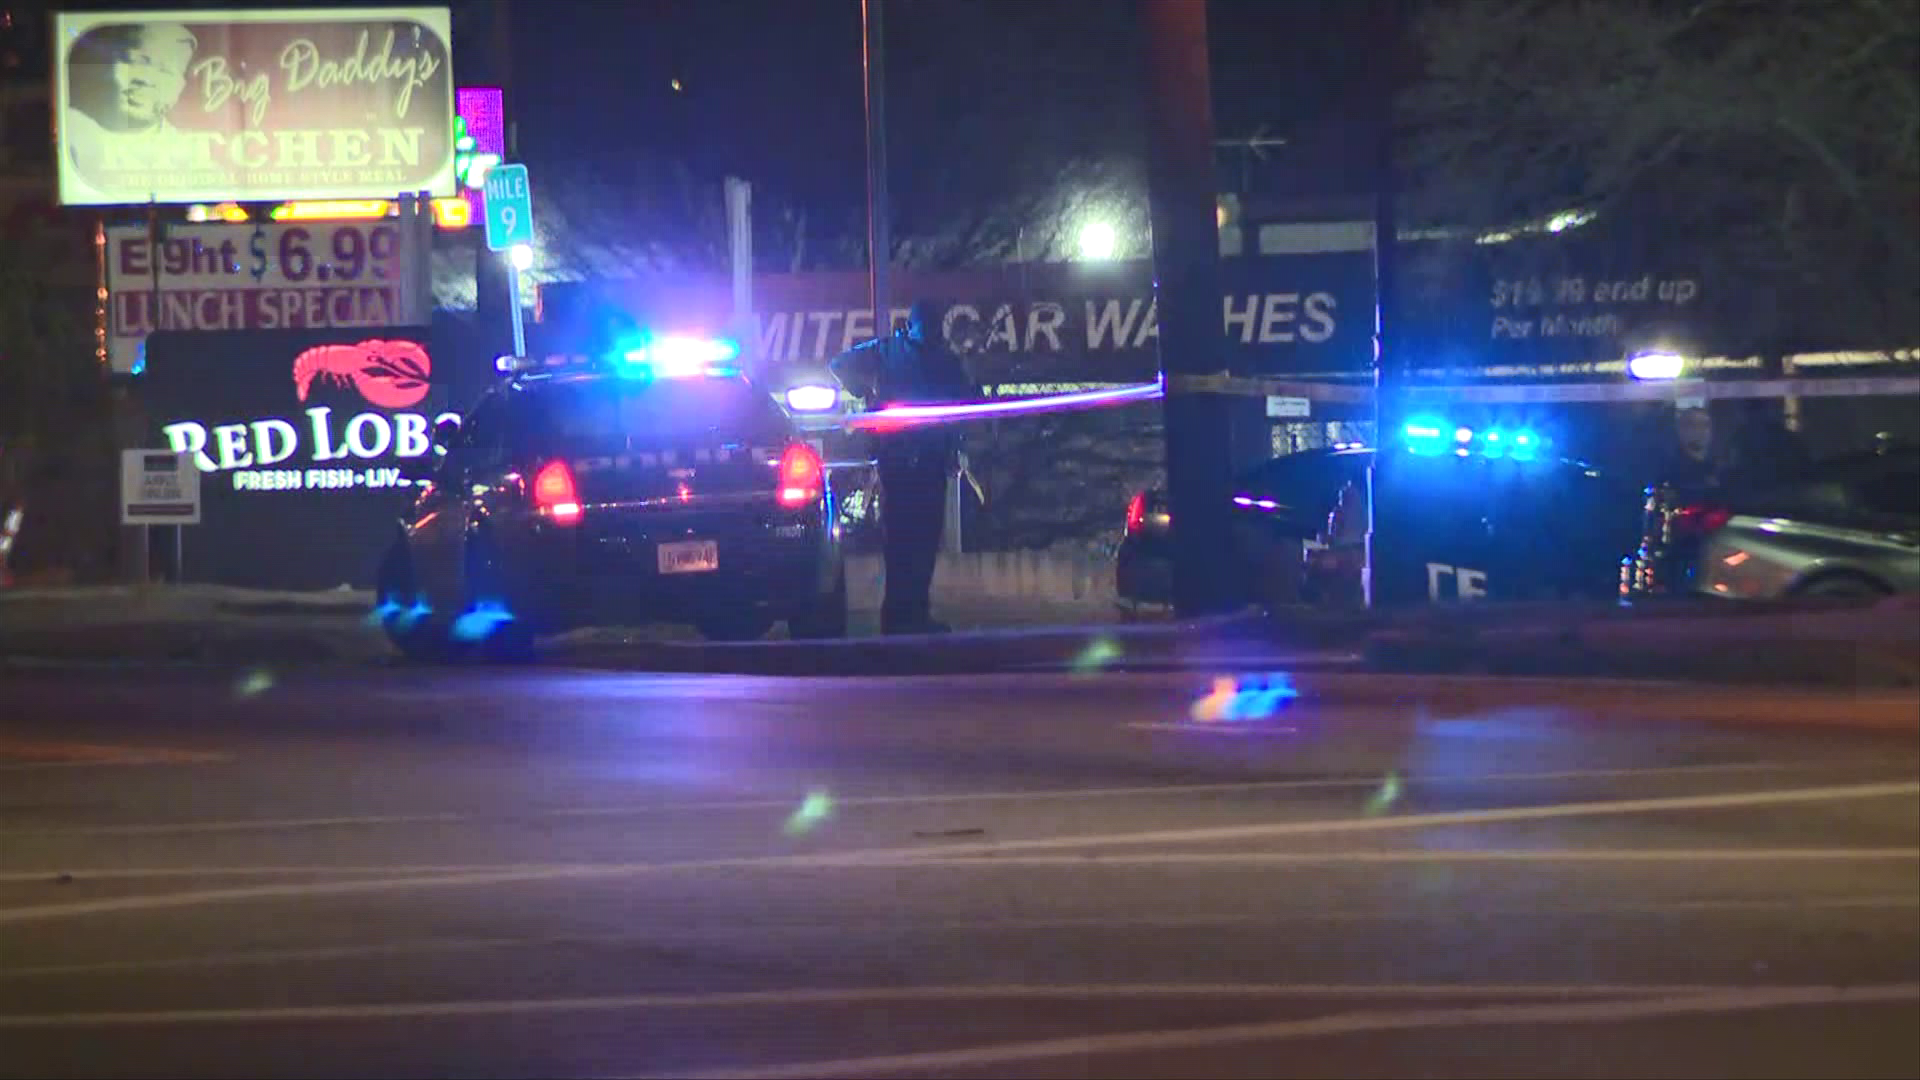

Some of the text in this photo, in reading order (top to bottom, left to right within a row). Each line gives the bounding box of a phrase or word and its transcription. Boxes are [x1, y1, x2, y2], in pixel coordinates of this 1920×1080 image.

[193, 26, 440, 127] Big Daddy's
[101, 127, 424, 170] KITCHEN
[487, 176, 525, 200] MILE
[501, 206, 517, 237] 9
[116, 289, 245, 335] LUNCH
[1658, 278, 1697, 305] up
[942, 301, 1066, 352] CAR
[1085, 291, 1336, 350] WAHES
[163, 418, 298, 472] RED
[233, 470, 302, 491] FRESH
